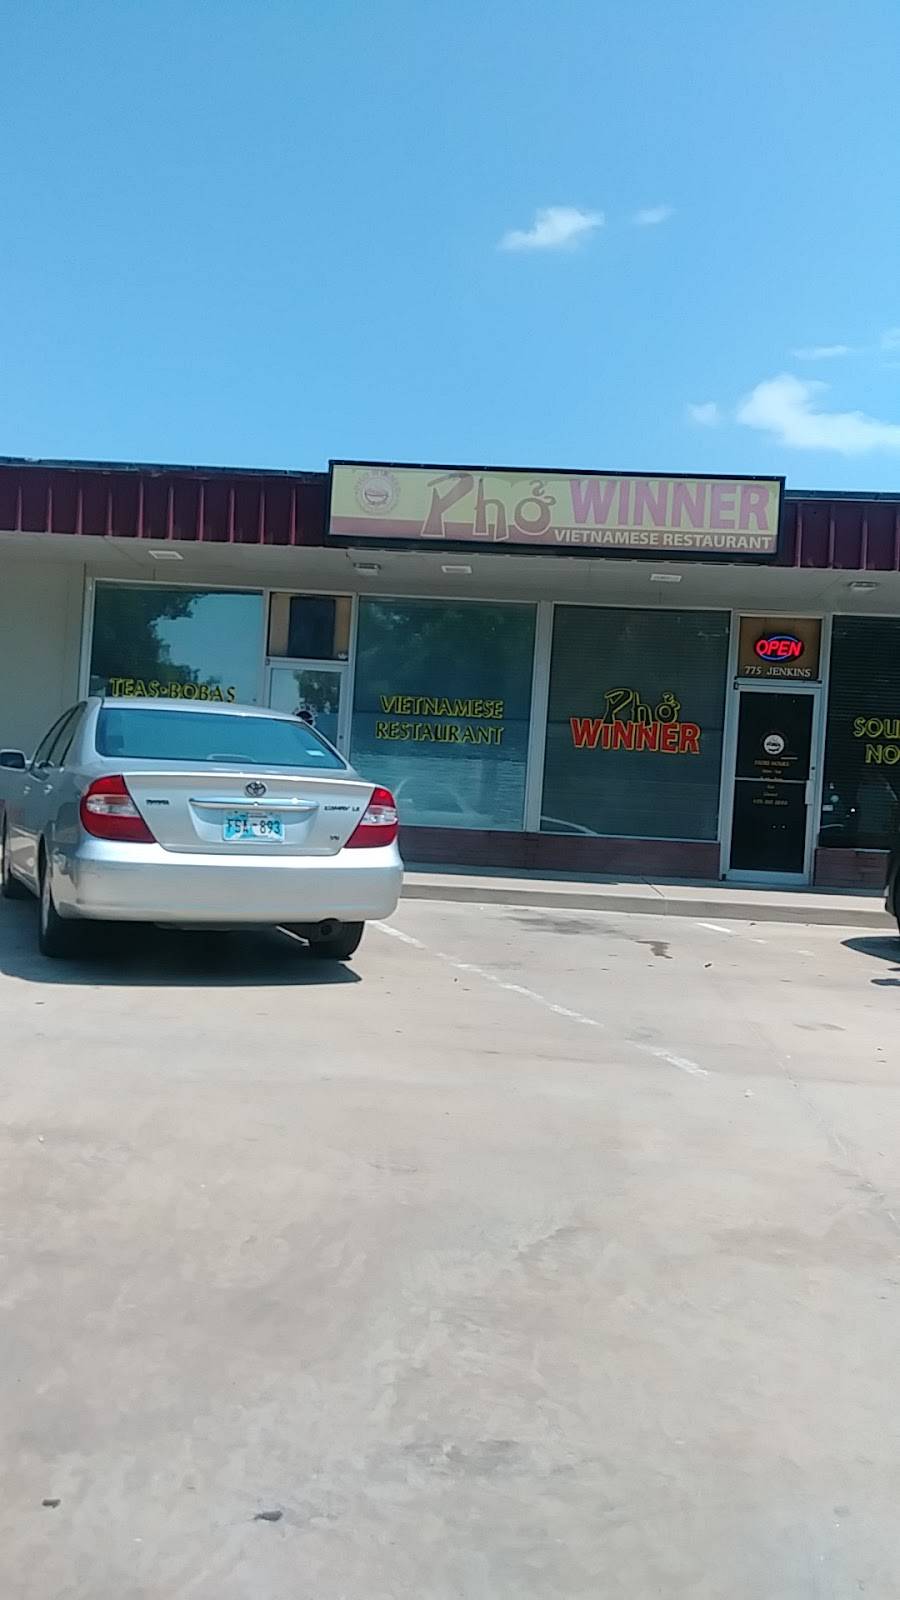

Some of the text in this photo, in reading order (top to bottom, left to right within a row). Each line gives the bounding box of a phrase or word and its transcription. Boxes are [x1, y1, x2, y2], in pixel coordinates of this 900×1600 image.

[569, 479, 770, 531] WINNER
[554, 530, 772, 550] VIETNAMESE RESTAURANT
[756, 639, 802, 657] OPEN
[744, 665, 811, 678] 775 JENKINS
[380, 694, 504, 719] VIETNAMESE
[376, 720, 504, 745] RESTAURANT
[570, 717, 702, 754] WINNER
